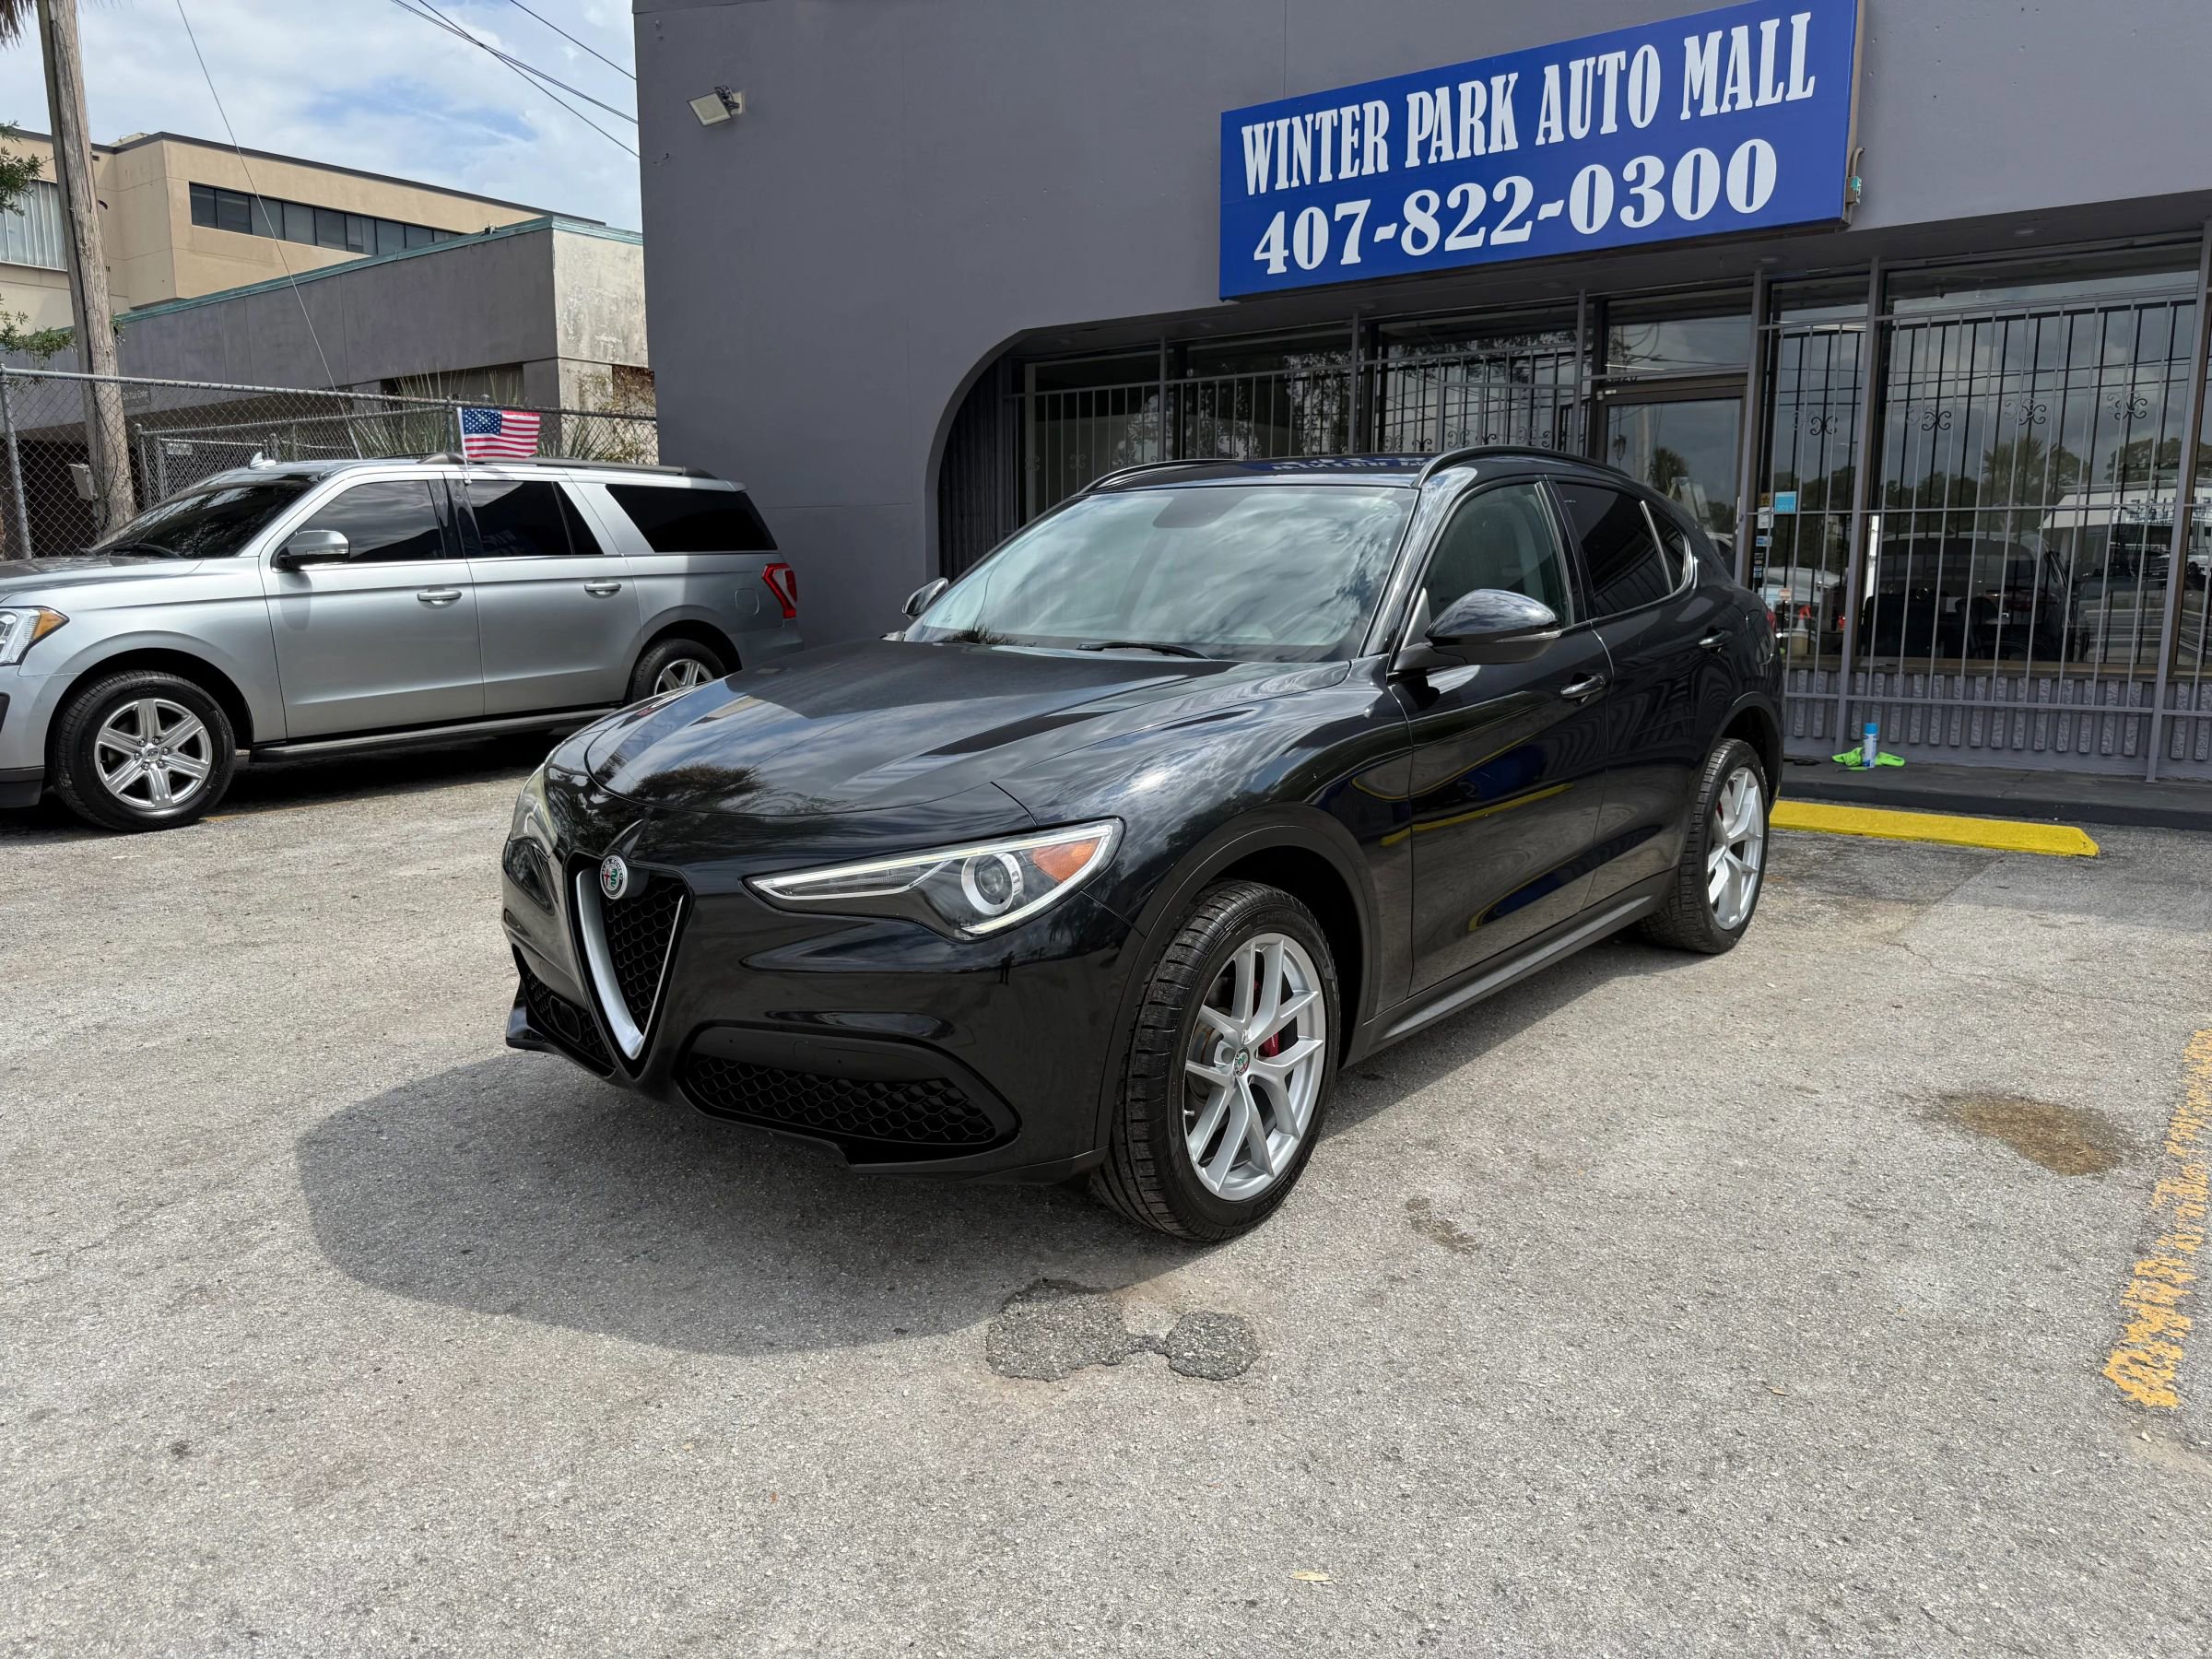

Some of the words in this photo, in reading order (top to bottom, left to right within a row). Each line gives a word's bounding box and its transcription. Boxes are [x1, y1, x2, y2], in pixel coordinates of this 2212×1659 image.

[1241, 100, 1390, 195] WINTER
[1405, 72, 1519, 169] PARK
[1535, 43, 1661, 146] AUTO
[1679, 11, 1816, 121] MALL
[1253, 138, 1777, 275] 407-822-0300
